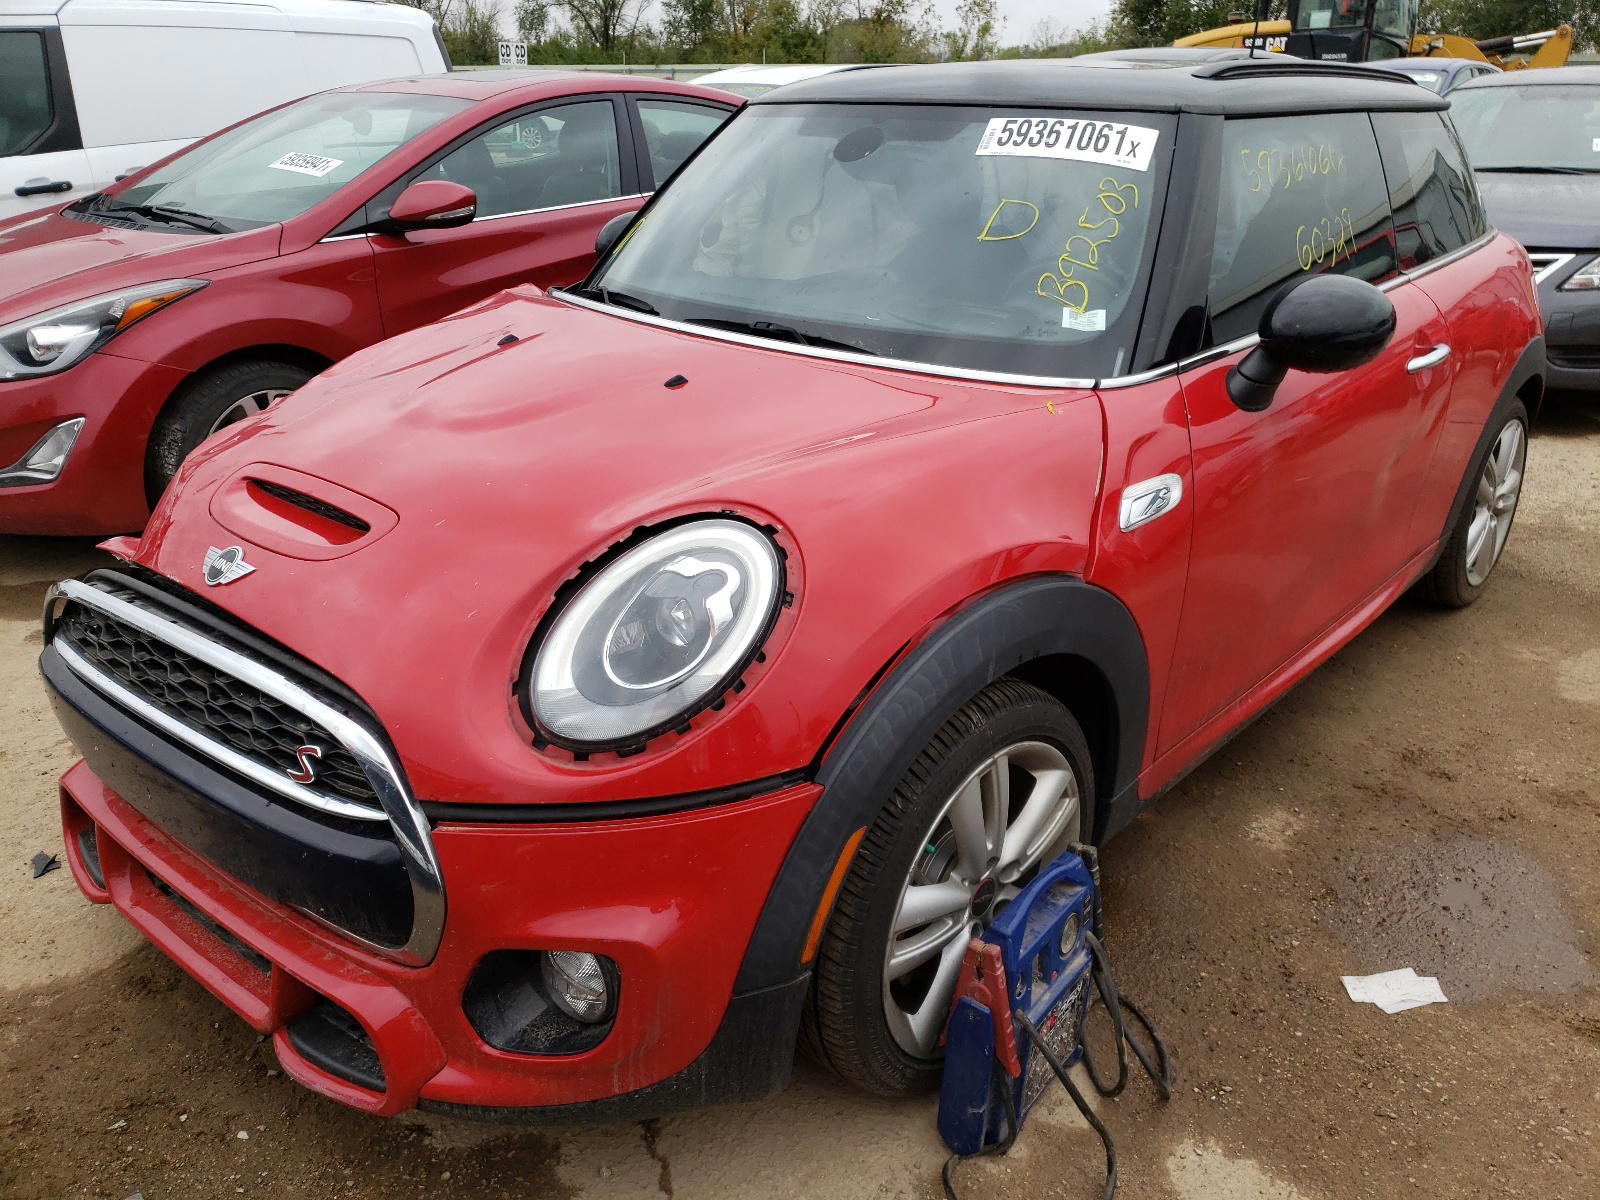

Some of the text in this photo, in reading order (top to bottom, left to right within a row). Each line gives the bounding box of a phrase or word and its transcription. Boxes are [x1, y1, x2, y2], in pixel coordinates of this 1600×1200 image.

[500, 44, 526, 58] CD CD
[1265, 37, 1288, 52] CAT
[286, 744, 322, 784] S
